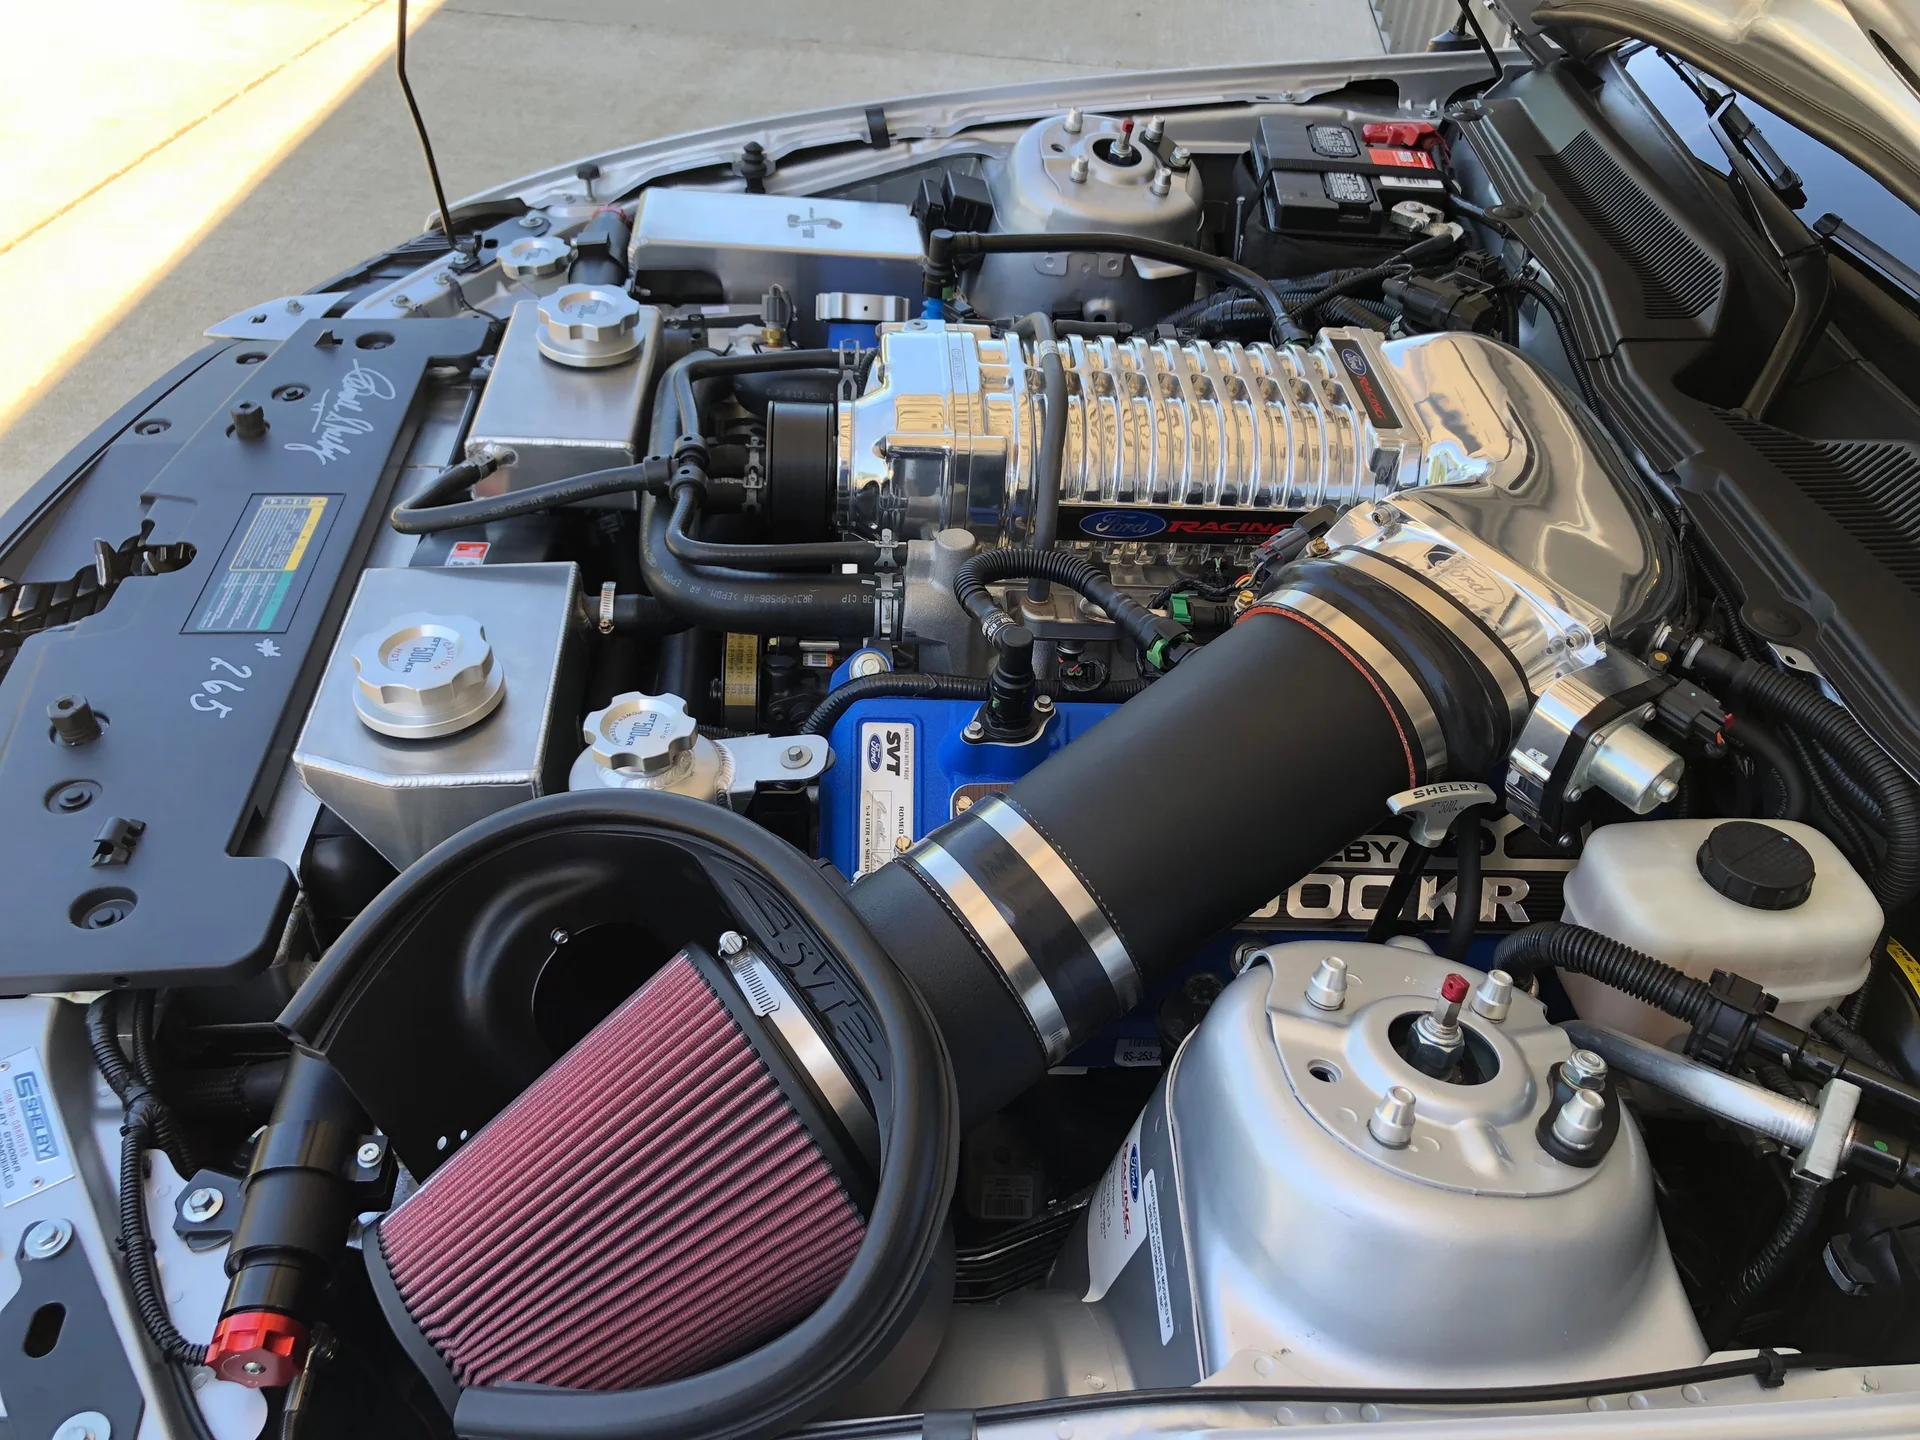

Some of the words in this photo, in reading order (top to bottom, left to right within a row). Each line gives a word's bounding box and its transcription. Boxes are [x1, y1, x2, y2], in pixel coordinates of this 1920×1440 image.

[1357, 376, 1387, 419] RACING
[1096, 514, 1150, 533] Ford
[1168, 521, 1294, 534] RACING
[1435, 560, 1494, 595] Ford
[391, 648, 403, 662] HOT
[402, 637, 442, 673] GT500KR
[434, 642, 454, 671] CAUTION
[190, 657, 252, 719] 265
[619, 711, 643, 722] POWER
[625, 713, 657, 746] GT500KR
[660, 723, 670, 739] FLUID
[869, 740, 881, 765] Ford
[886, 730, 901, 777] SVT
[1413, 783, 1480, 799] SHELBY
[864, 837, 871, 846] 4V
[776, 932, 858, 1013] SVT
[26, 1098, 54, 1159] SHELBY
[3, 1131, 22, 1172] GT500KR
[1130, 1156, 1138, 1193] Ford
[1147, 1203, 1156, 1235] SHELBY
[1155, 1234, 1165, 1274] CONTROL
[1161, 1276, 1169, 1315] MODIFIED
[1165, 1316, 1171, 1328] BY
